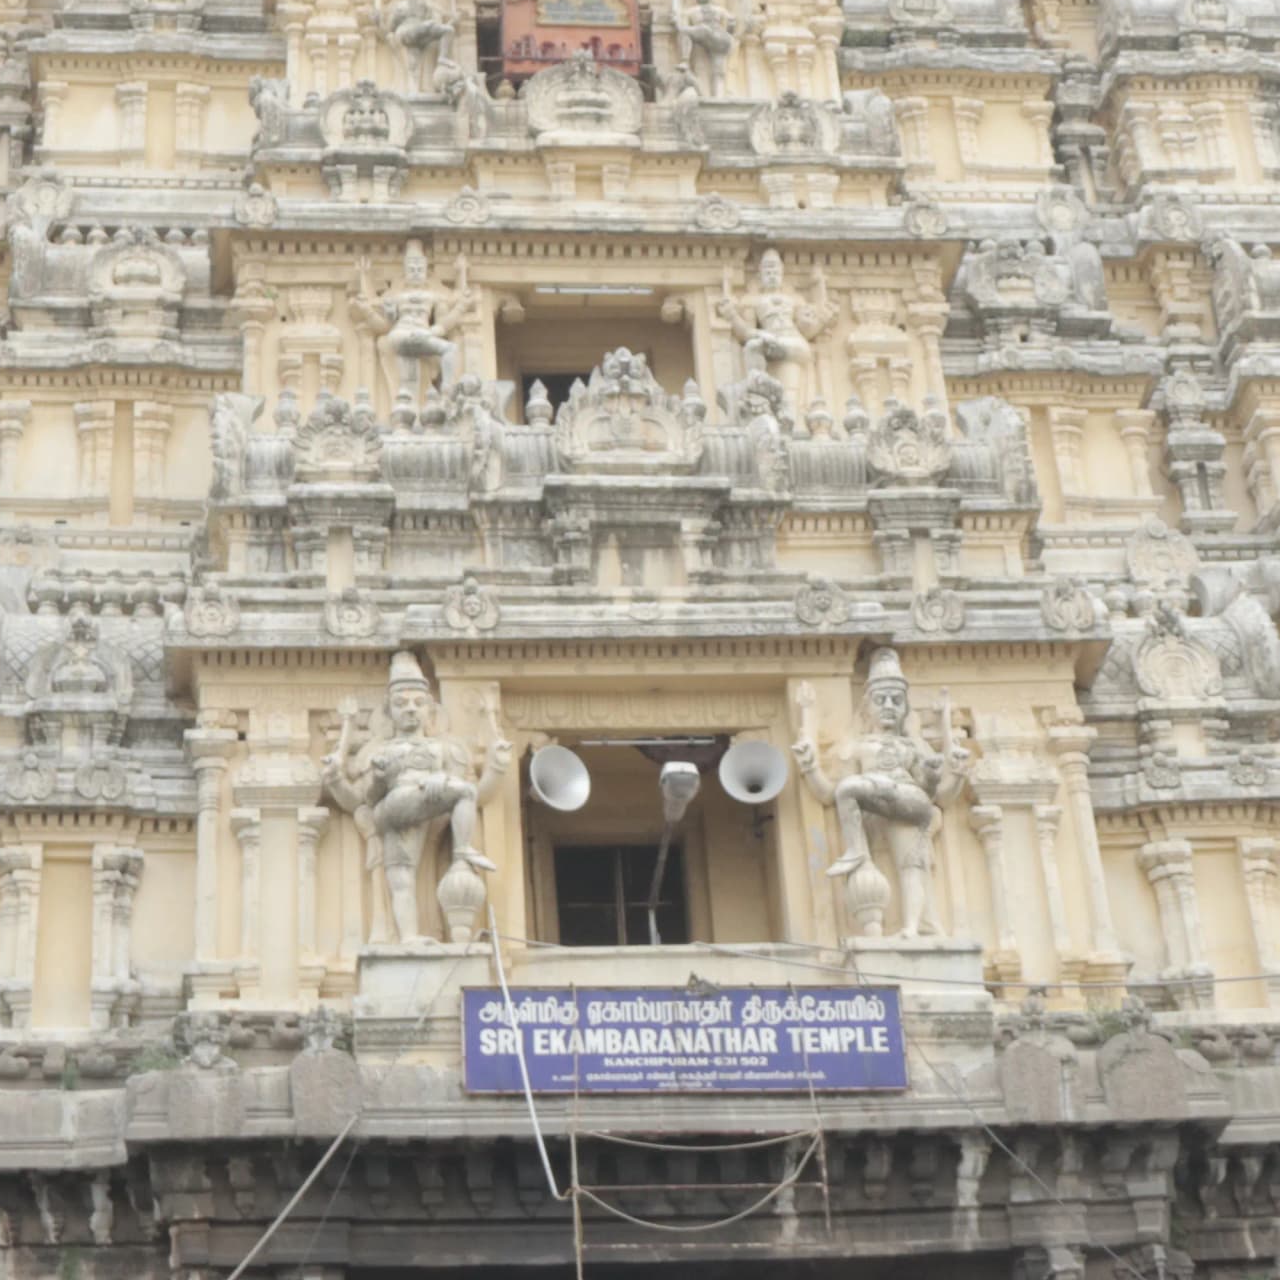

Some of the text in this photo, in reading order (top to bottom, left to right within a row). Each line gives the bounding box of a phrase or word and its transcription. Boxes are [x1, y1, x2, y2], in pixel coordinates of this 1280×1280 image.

[587, 996, 732, 1026] ஏகாம்பரநாதர்
[742, 994, 885, 1026] திருக்கோயில்
[479, 1026, 889, 1055] SRI EKAMBARANATHAR TEMPLE
[740, 1056, 768, 1067] 502
